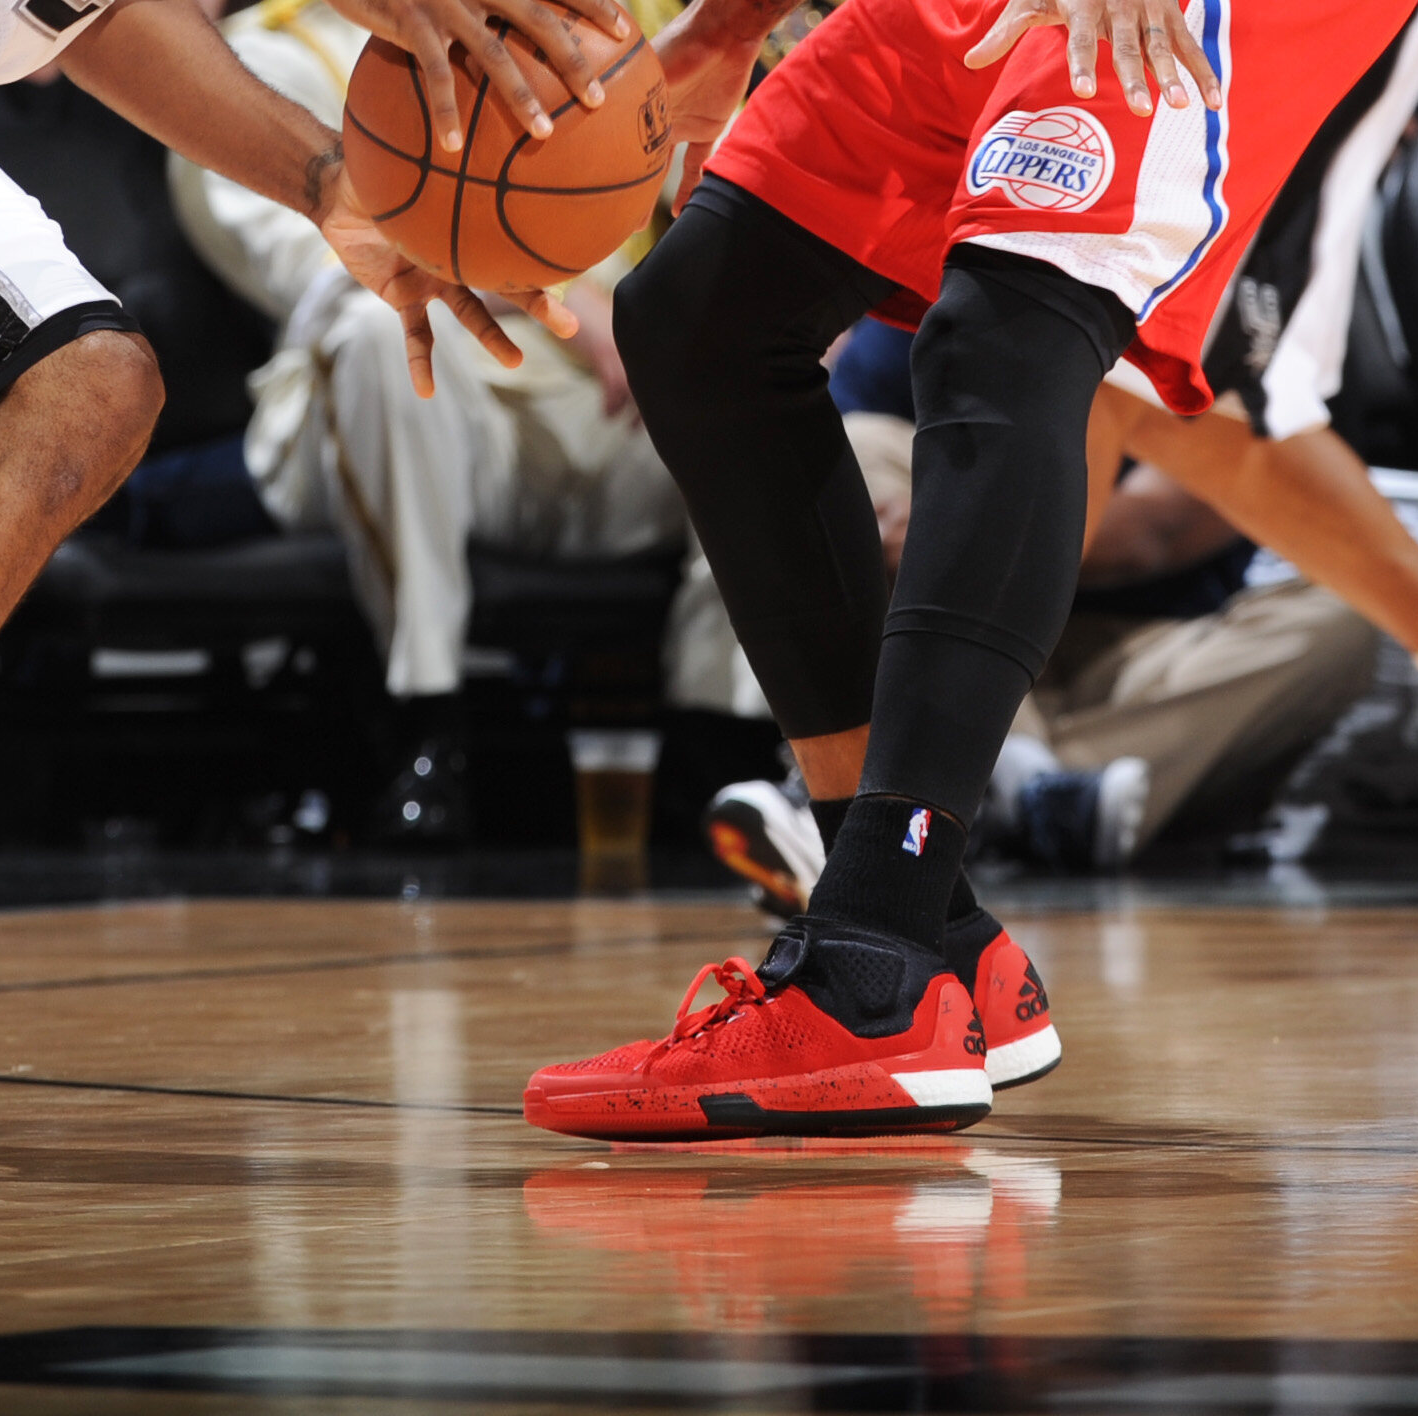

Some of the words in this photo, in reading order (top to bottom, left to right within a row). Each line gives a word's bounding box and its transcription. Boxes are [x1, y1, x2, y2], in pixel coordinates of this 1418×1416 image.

[971, 136, 1092, 193] CLIPPERS
[1017, 140, 1039, 152] LOS
[1040, 145, 1097, 168] ANGELES
